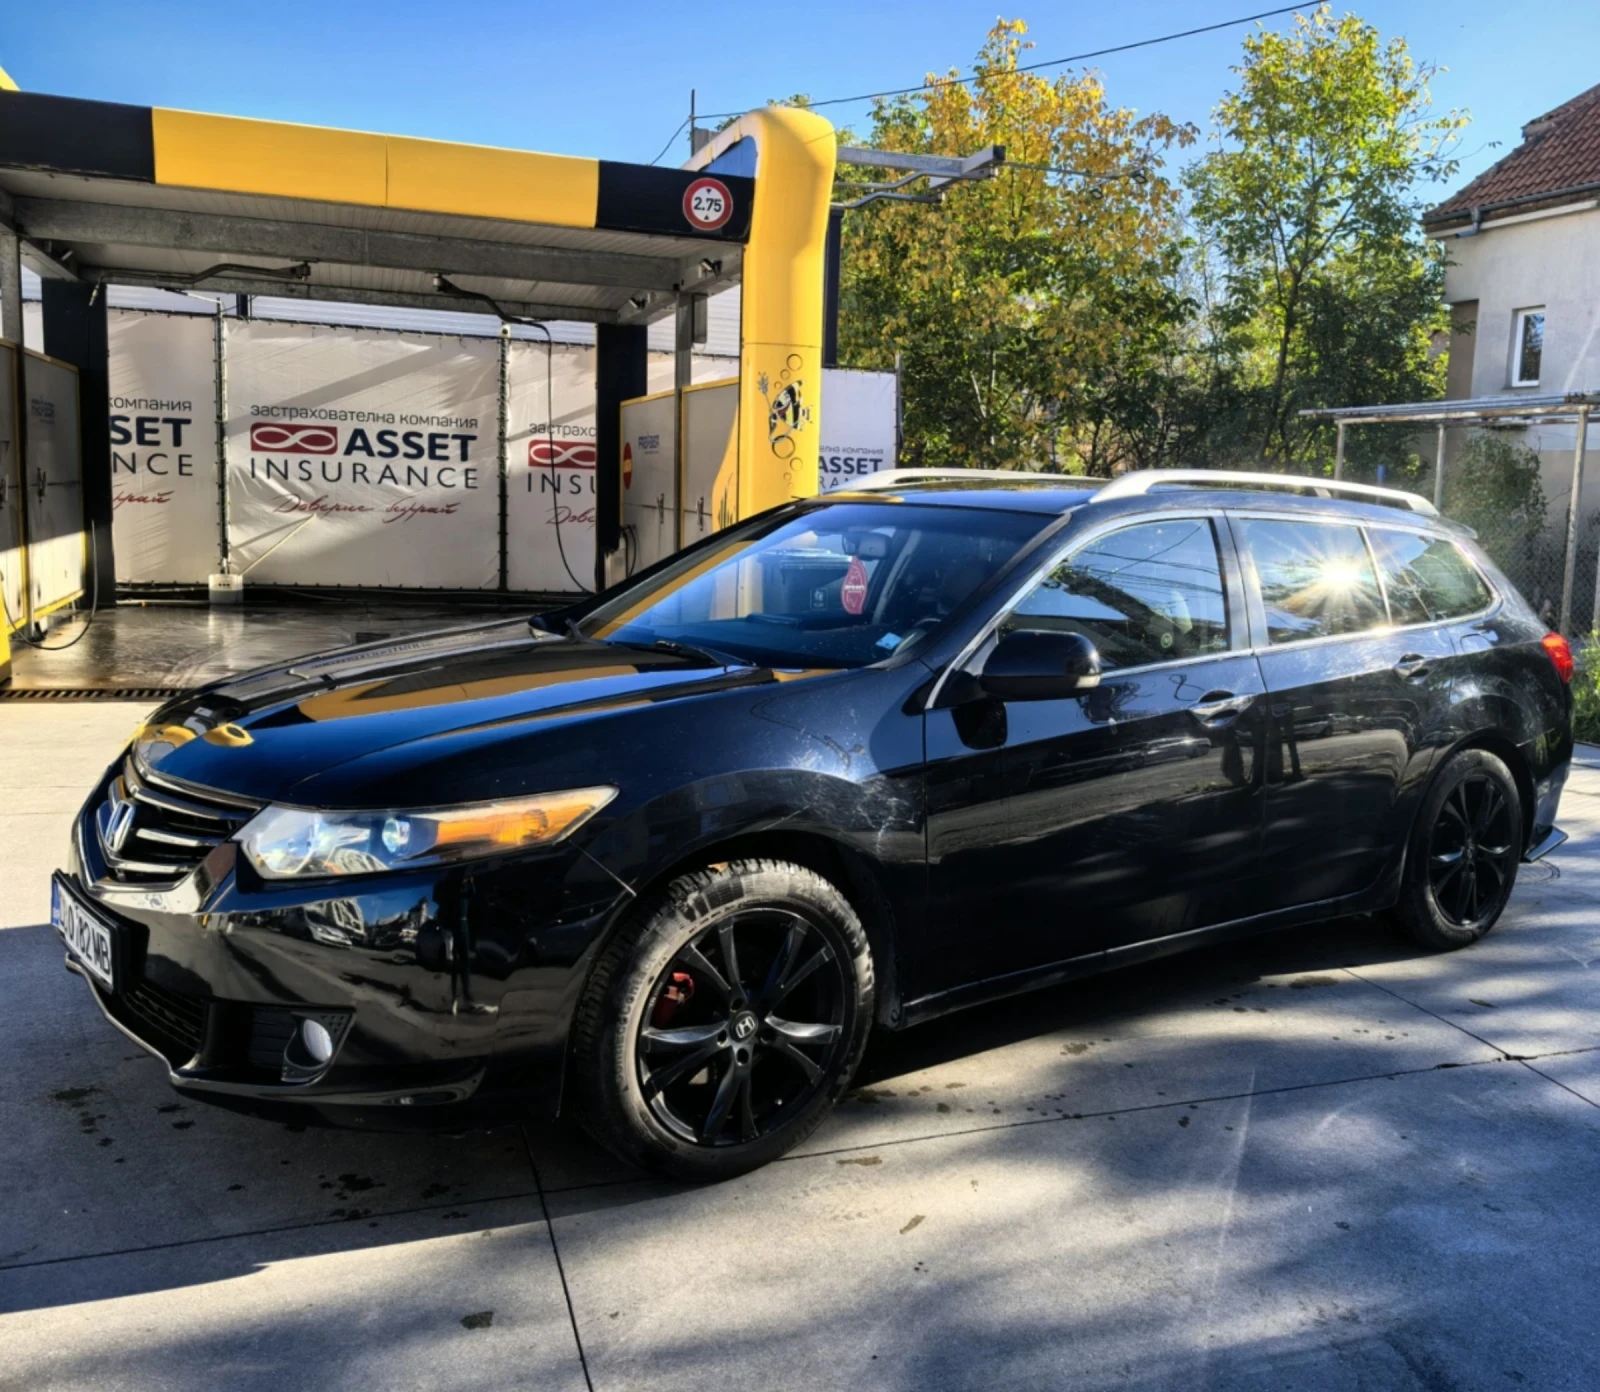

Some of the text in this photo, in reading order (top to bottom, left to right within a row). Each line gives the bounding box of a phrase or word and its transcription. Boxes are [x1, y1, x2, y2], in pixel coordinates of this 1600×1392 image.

[694, 196, 722, 213] 2.75
[250, 404, 478, 429] застрахователна компания
[109, 415, 192, 447] SET
[343, 428, 478, 462] ASSET
[112, 451, 193, 477] NCE
[250, 457, 479, 489] INSURANCE
[818, 455, 883, 475] ASSET
[527, 472, 596, 495] INS
